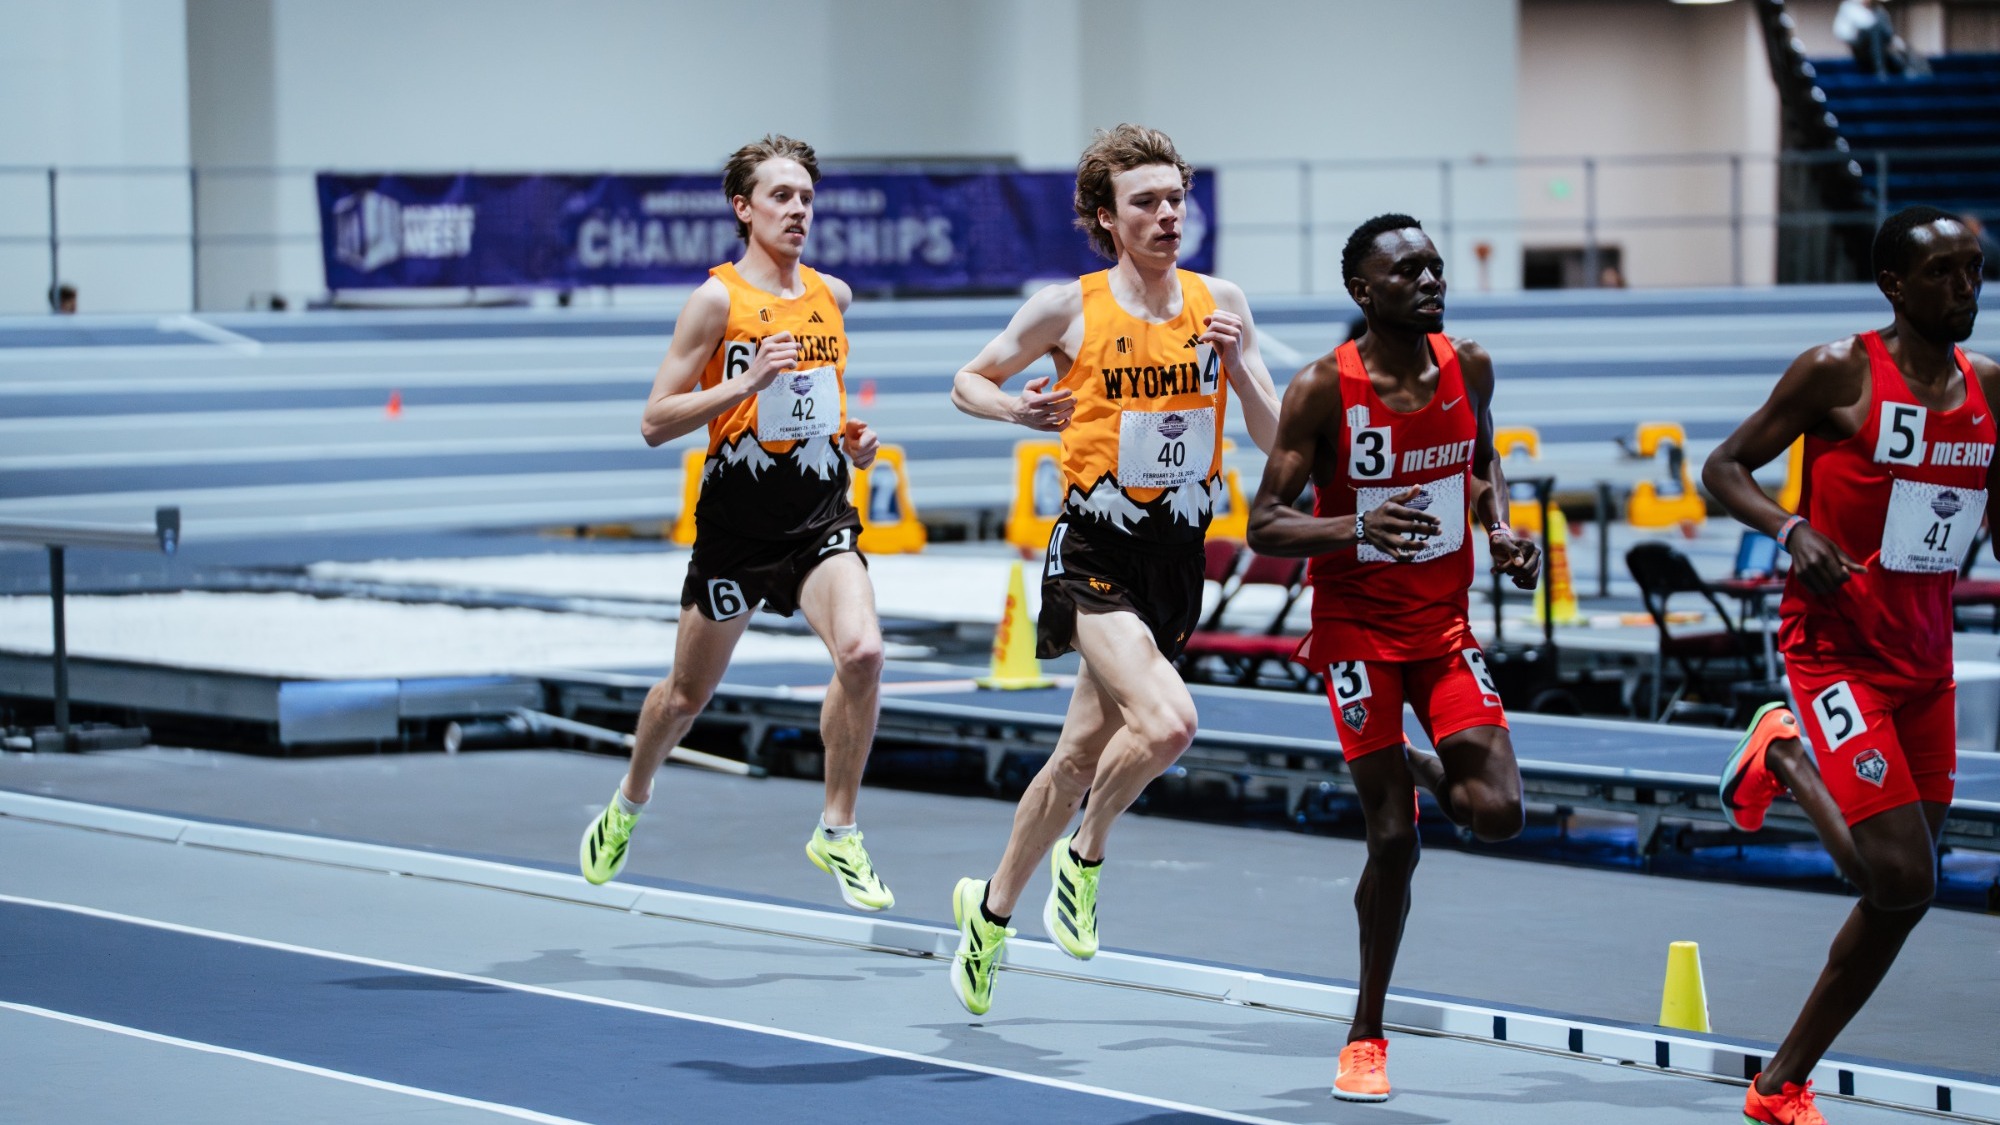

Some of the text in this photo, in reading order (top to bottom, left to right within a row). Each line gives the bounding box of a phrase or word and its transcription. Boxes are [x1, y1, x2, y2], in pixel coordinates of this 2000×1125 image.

[578, 216, 954, 268] CHAMPSHIPS
[726, 345, 750, 380] 6
[750, 335, 839, 363] MING
[1102, 362, 1201, 400] WYOMIN
[1203, 347, 1219, 390] 4
[791, 397, 816, 421] 42
[1889, 407, 1918, 459] 5
[1157, 441, 1186, 468] 40
[1355, 431, 1386, 477] 3
[1050, 527, 1062, 571] 4
[1923, 522, 1952, 552] 41
[713, 582, 742, 616] 6
[1333, 661, 1363, 699] 3
[1471, 651, 1498, 693] 3
[1821, 688, 1853, 741] 5
